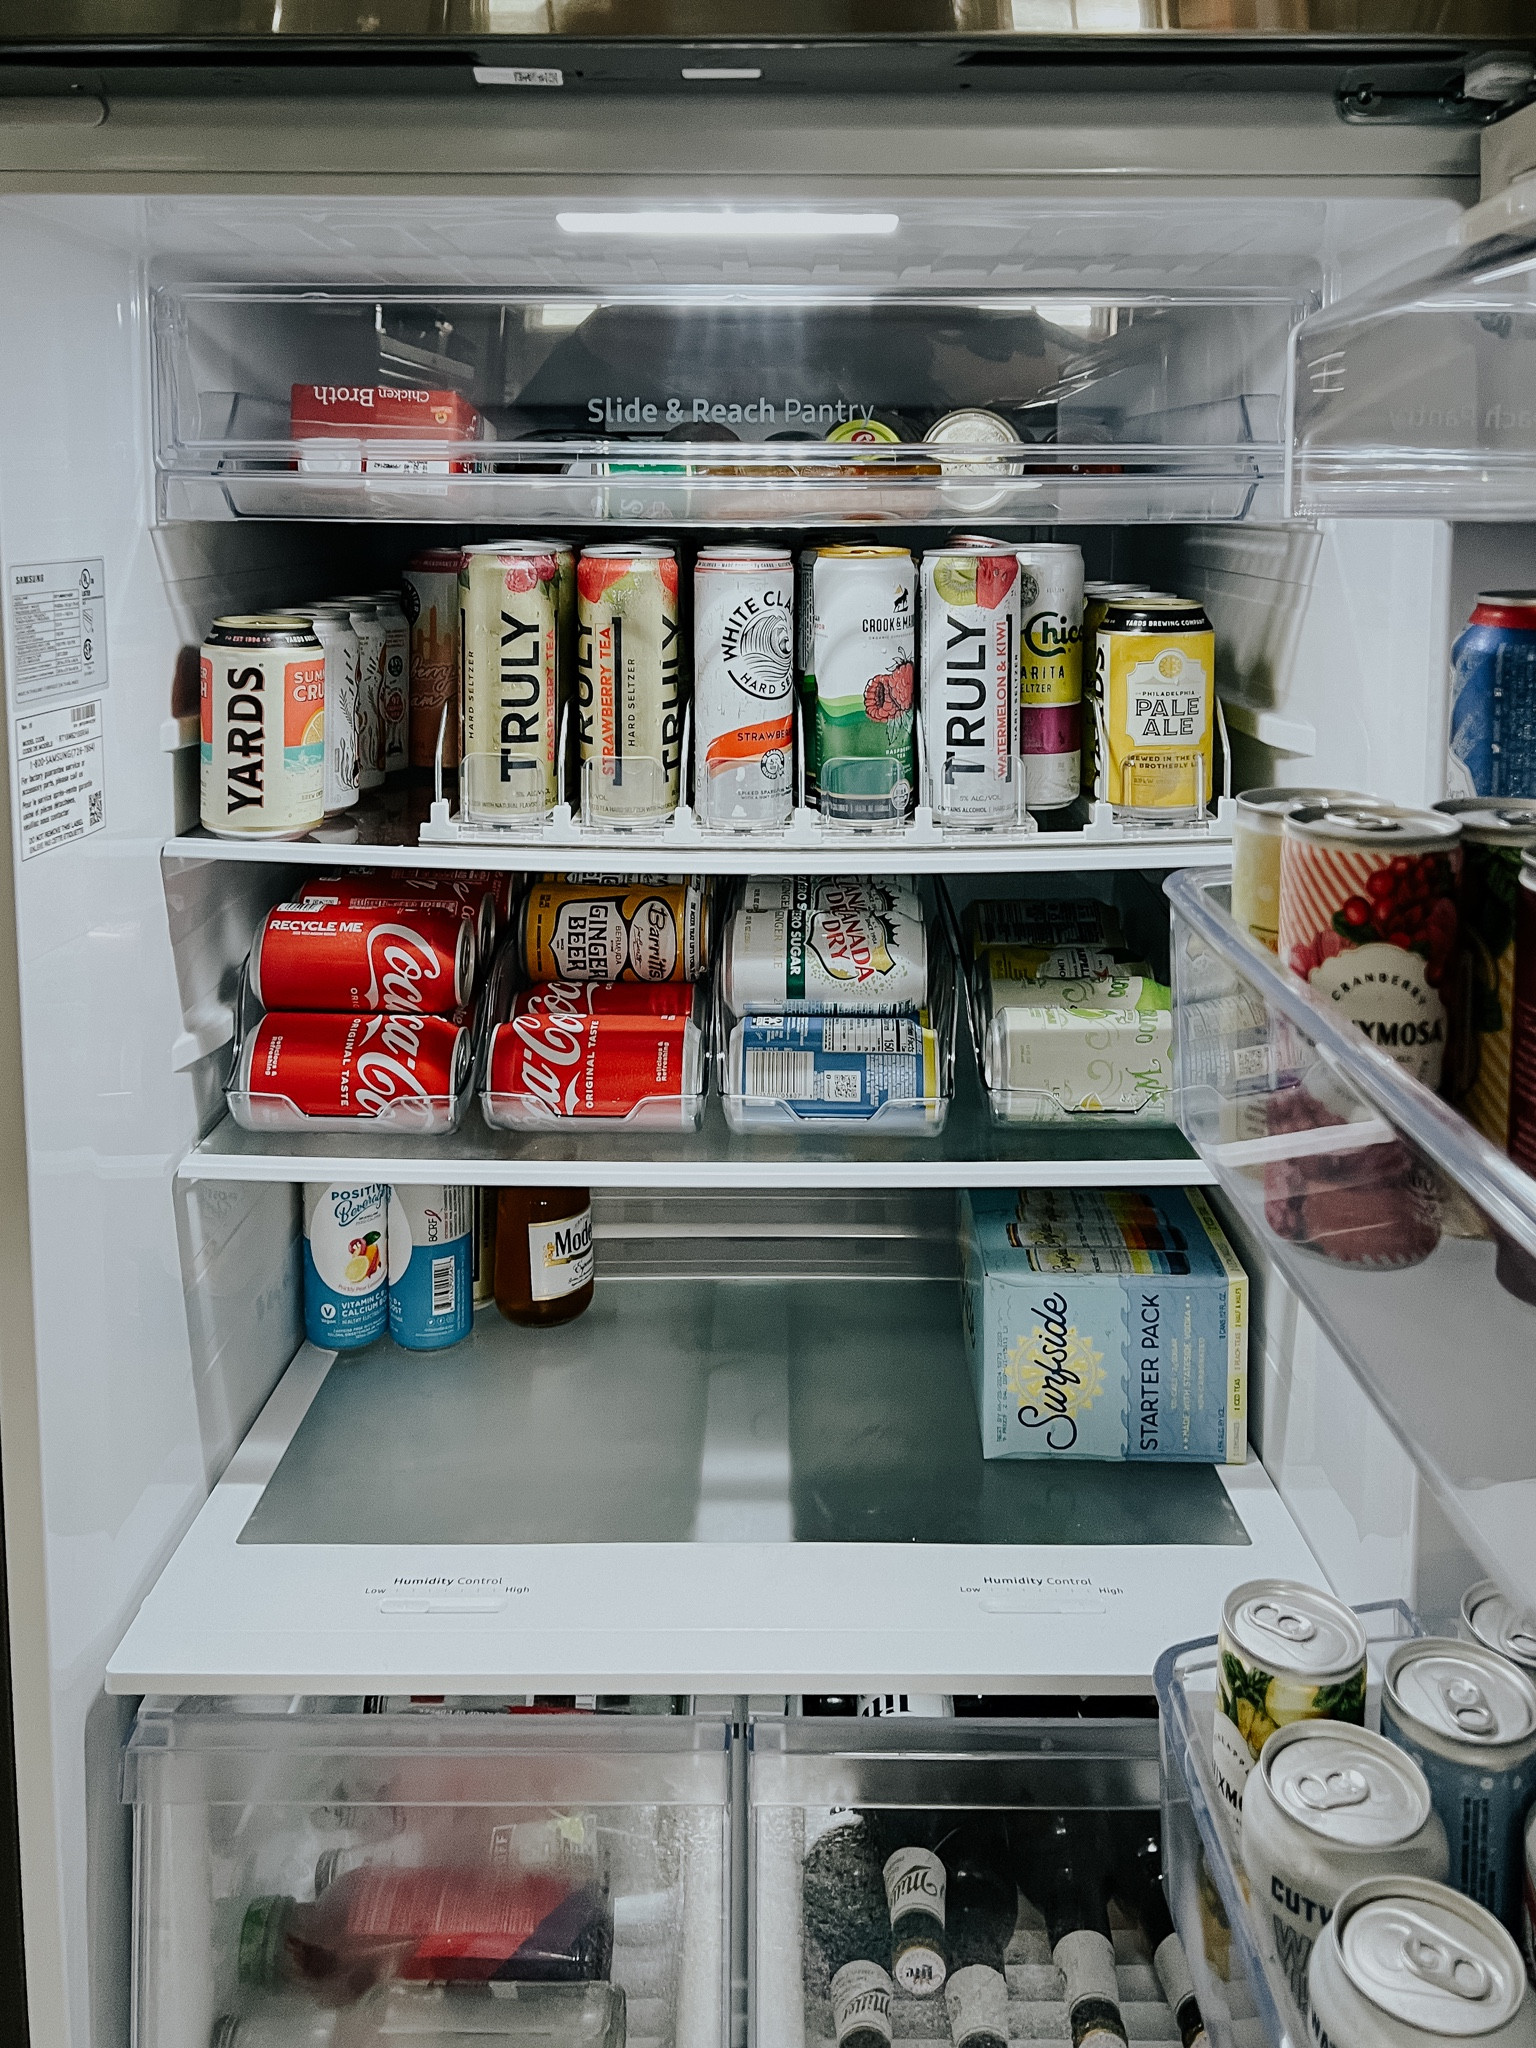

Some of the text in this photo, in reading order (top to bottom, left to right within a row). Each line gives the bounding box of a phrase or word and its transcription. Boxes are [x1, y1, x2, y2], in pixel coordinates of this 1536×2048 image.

[313, 385, 430, 408] Chicken Broth
[587, 397, 875, 427] Slide & Reach Pantry
[15, 574, 44, 584] SAMSUNG
[721, 597, 760, 661] WHITE
[862, 617, 895, 632] CROOK
[896, 617, 901, 631] &
[1148, 619, 1180, 627] BREWING
[500, 610, 540, 782] TRULY
[545, 629, 555, 762] RASPBERRY TEA
[740, 672, 776, 694] HARD
[1021, 680, 1052, 693] ELTZER
[599, 627, 615, 776] STRAWBERRY TEA
[627, 658, 636, 747] HARD SELTZER
[945, 614, 987, 785] TRULY
[996, 621, 1008, 778] WATERMELON & KIWI
[1135, 697, 1200, 717] PALE
[227, 667, 265, 815] YARDS
[1142, 717, 1194, 736] ALE
[1163, 754, 1171, 762] IN
[269, 920, 364, 933] RECYCLE ME
[588, 904, 608, 980] GINGER
[821, 918, 851, 960] DRY
[566, 916, 587, 971] BEER
[773, 946, 783, 969] ALE
[789, 931, 802, 976] SUGAR
[1331, 973, 1427, 1005] CRANBERRY
[265, 1035, 278, 1076] Refreshing
[272, 1036, 283, 1069] Delicious
[661, 1041, 670, 1082] Refreshing
[884, 1039, 894, 1052] 150
[341, 1018, 361, 1107] ORIGINAL TASTE
[586, 1020, 599, 1109] ORIGINAL TASTE
[655, 1047, 664, 1082] Delicious
[428, 1218, 438, 1242] BCRF
[341, 1296, 375, 1310] VITAMIN
[341, 1304, 378, 1318] CALCIUM
[1017, 1291, 1081, 1451] Surfside
[1140, 1293, 1160, 1451] STARTER PACK
[1183, 1342, 1192, 1387] STATESIDE
[1182, 1415, 1190, 1437] MADE
[394, 1577, 503, 1586] Humidity Control
[505, 1586, 530, 1594] High
[983, 1577, 1092, 1586] Humidity Control
[1099, 1587, 1124, 1595] High
